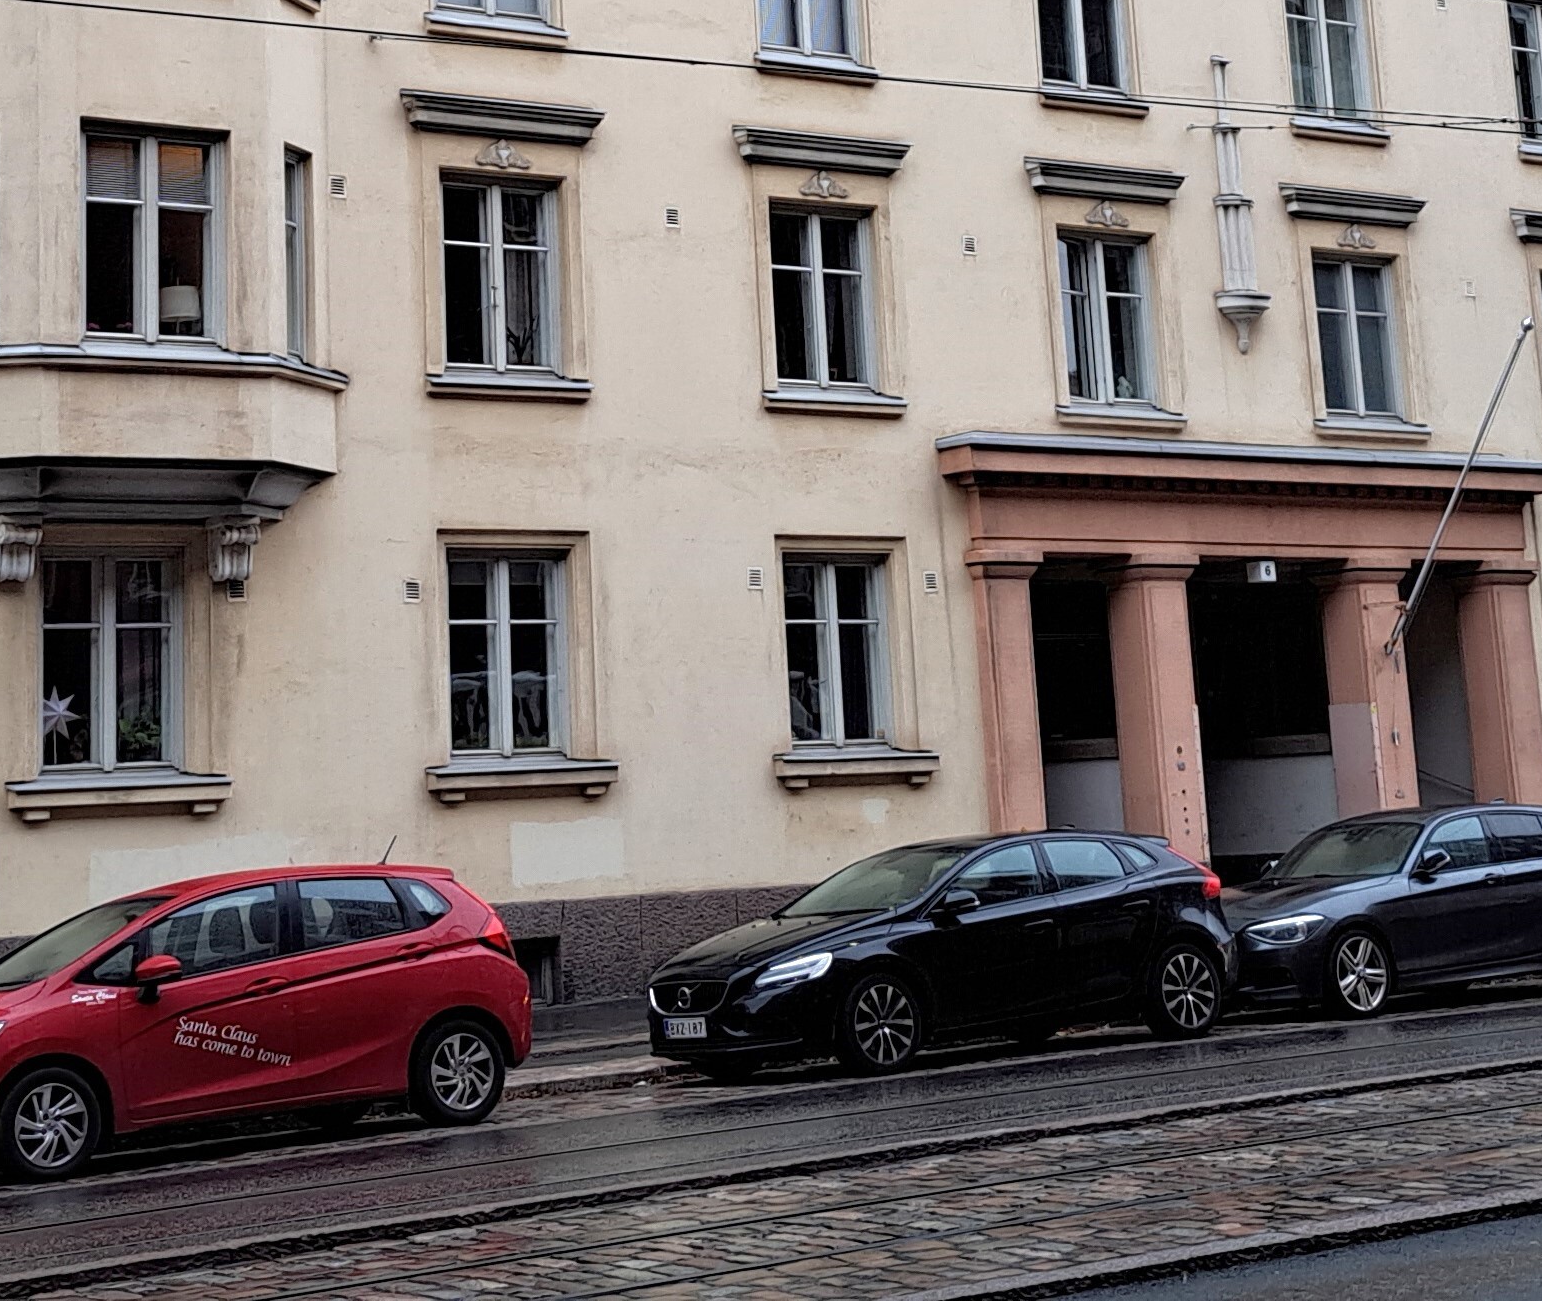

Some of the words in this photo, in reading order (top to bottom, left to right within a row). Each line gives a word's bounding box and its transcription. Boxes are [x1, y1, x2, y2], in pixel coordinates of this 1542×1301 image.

[1264, 565, 1271, 576] 6
[176, 1016, 217, 1037] Santa
[221, 1025, 259, 1045] Claus
[173, 1029, 200, 1048] has
[202, 1039, 238, 1056] come
[240, 1044, 255, 1059] to
[256, 1048, 292, 1067] town
